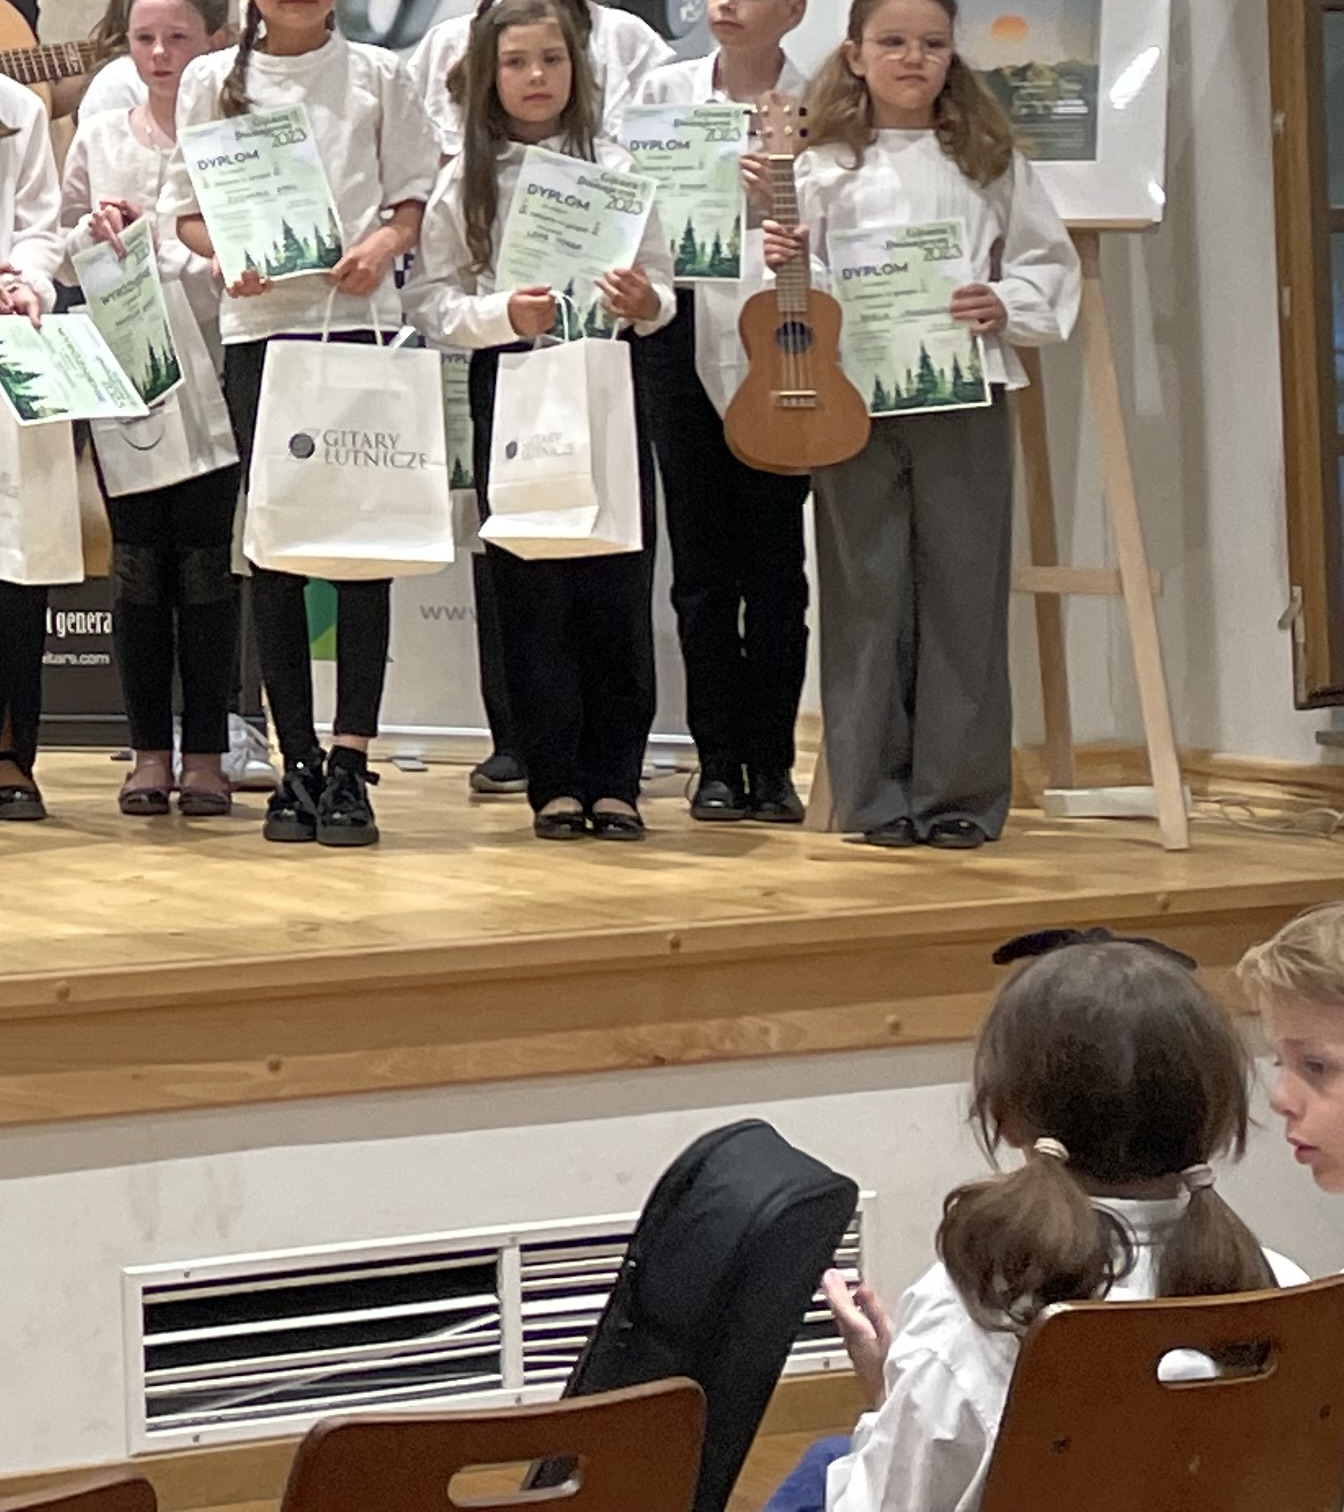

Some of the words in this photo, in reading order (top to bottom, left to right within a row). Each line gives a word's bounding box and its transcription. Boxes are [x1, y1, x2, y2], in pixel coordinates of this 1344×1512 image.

[629, 139, 690, 151] DYPLOM
[197, 149, 259, 171] DYPLOM
[527, 184, 591, 211] DYPLOM
[842, 262, 908, 280] DYPLOM
[323, 429, 401, 449] GITARY
[56, 611, 112, 638] genera
